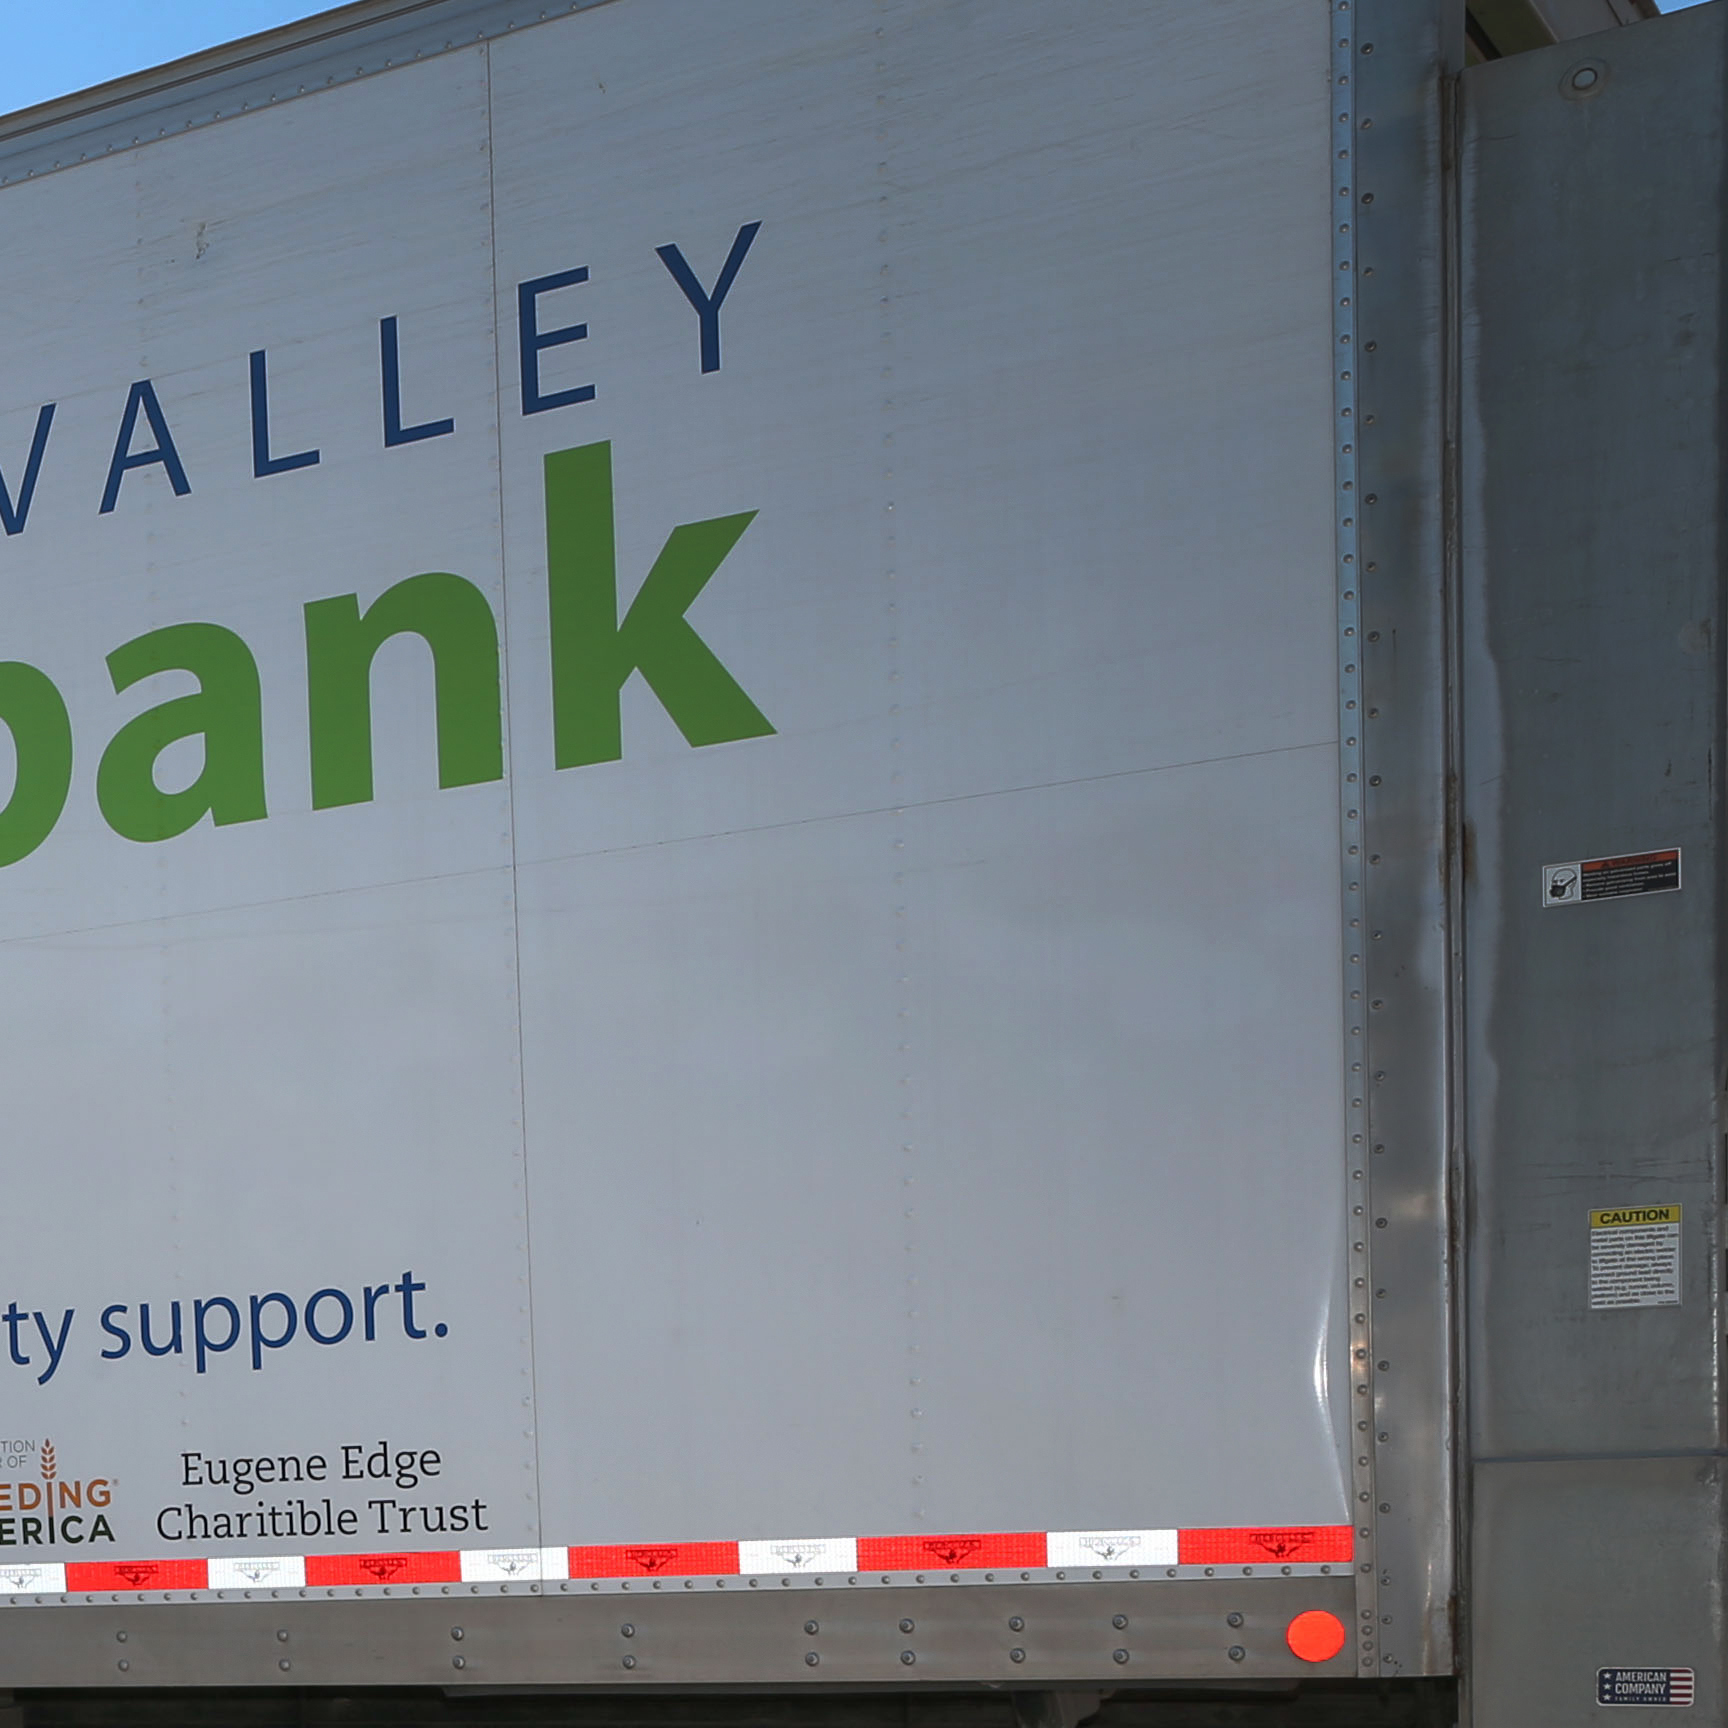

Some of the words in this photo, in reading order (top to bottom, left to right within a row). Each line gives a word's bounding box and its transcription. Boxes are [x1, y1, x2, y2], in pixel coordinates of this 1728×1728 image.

[1599, 1208, 1670, 1225] CAUTION
[99, 1269, 450, 1375] support.
[6, 1454, 28, 1469] OF
[180, 1452, 329, 1497] Eugene
[340, 1441, 442, 1489] Edge
[155, 1498, 358, 1542] Charitible
[367, 1498, 490, 1534] Trust
[1615, 1671, 1667, 1682] AMERICAN
[1614, 1683, 1666, 1694] COMPANY
